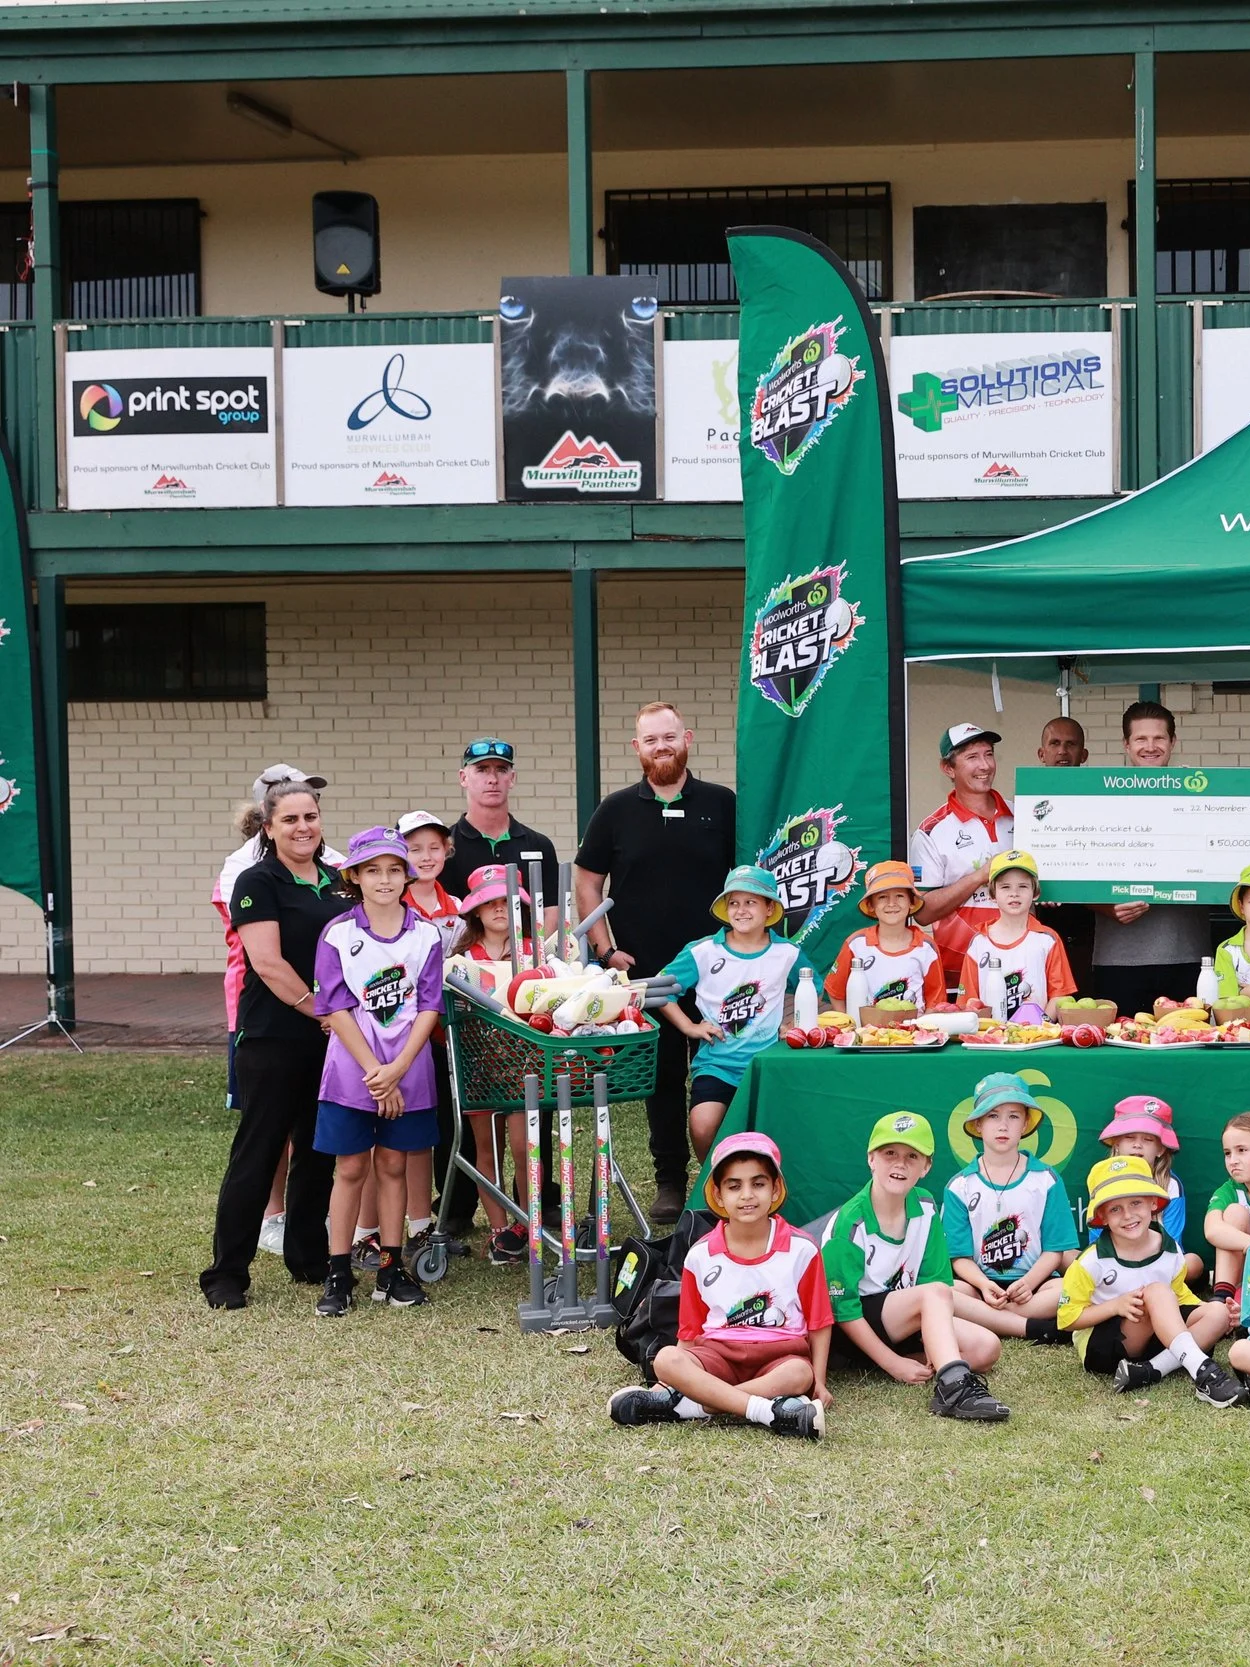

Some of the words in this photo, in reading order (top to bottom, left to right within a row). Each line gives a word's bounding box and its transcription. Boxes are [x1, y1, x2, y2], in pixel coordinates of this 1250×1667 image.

[941, 356, 1101, 396] SOLUTIONS
[760, 367, 817, 413] CRICKET
[957, 371, 1105, 409] MEDICAL
[128, 385, 191, 416] print
[196, 384, 260, 415] spot
[943, 411, 981, 425] QUALITY
[988, 404, 1036, 417] PRECISION
[1044, 393, 1105, 408] TECHNOLOGY
[218, 410, 260, 425] group
[752, 380, 837, 444] BLAST
[346, 433, 432, 442] MURWILLUMBAH
[347, 442, 399, 454] SERVICES
[402, 442, 431, 453] CLUB
[898, 453, 925, 461] Proud
[928, 453, 969, 461] sponsors
[971, 451, 980, 459] of
[983, 451, 1047, 459] Murwillumbah
[1050, 450, 1082, 458] Cricket
[1085, 449, 1106, 457] Club
[73, 465, 98, 473] Proud
[100, 464, 138, 473] sponsors
[140, 463, 149, 472] of
[151, 463, 214, 472] Murwillumbah
[215, 462, 248, 471] Cricket
[250, 462, 271, 470] Club
[291, 462, 318, 471] Proud
[319, 461, 359, 470] sponsors
[361, 461, 370, 469] of
[372, 460, 434, 469] Murwillumbah
[436, 459, 468, 468] Cricket
[470, 459, 490, 467] Club
[671, 456, 699, 465] Proud
[701, 457, 740, 465] sponsors
[526, 469, 638, 480] Murwillumbah
[581, 480, 637, 489] Panthers
[759, 609, 824, 649] CRICKET
[752, 624, 838, 680] BLAST
[1103, 774, 1181, 789] Woolworths
[1204, 804, 1247, 812] November
[1099, 825, 1132, 833] Cricket
[1134, 825, 1152, 833] Club
[1065, 839, 1086, 850] Fifty
[1090, 840, 1125, 848] thousand
[1127, 840, 1154, 848] dollars
[1209, 839, 1214, 847] $
[776, 867, 835, 910] AST
[1112, 885, 1129, 894] Pick
[1131, 885, 1152, 895] fresh
[1154, 891, 1172, 901] Play
[1174, 891, 1196, 900] fresh
[365, 980, 399, 999] CRICKET
[364, 987, 408, 1011] BLAST
[721, 996, 752, 1013] CRICKET
[718, 1003, 760, 1024] BLAST
[529, 1156, 540, 1240] playcricket.com.au
[562, 1156, 572, 1240] playcricket.com.au
[599, 1152, 609, 1235] playcricket.com.au
[984, 1233, 1014, 1251] CRICKET
[981, 1242, 1022, 1264] BLAST
